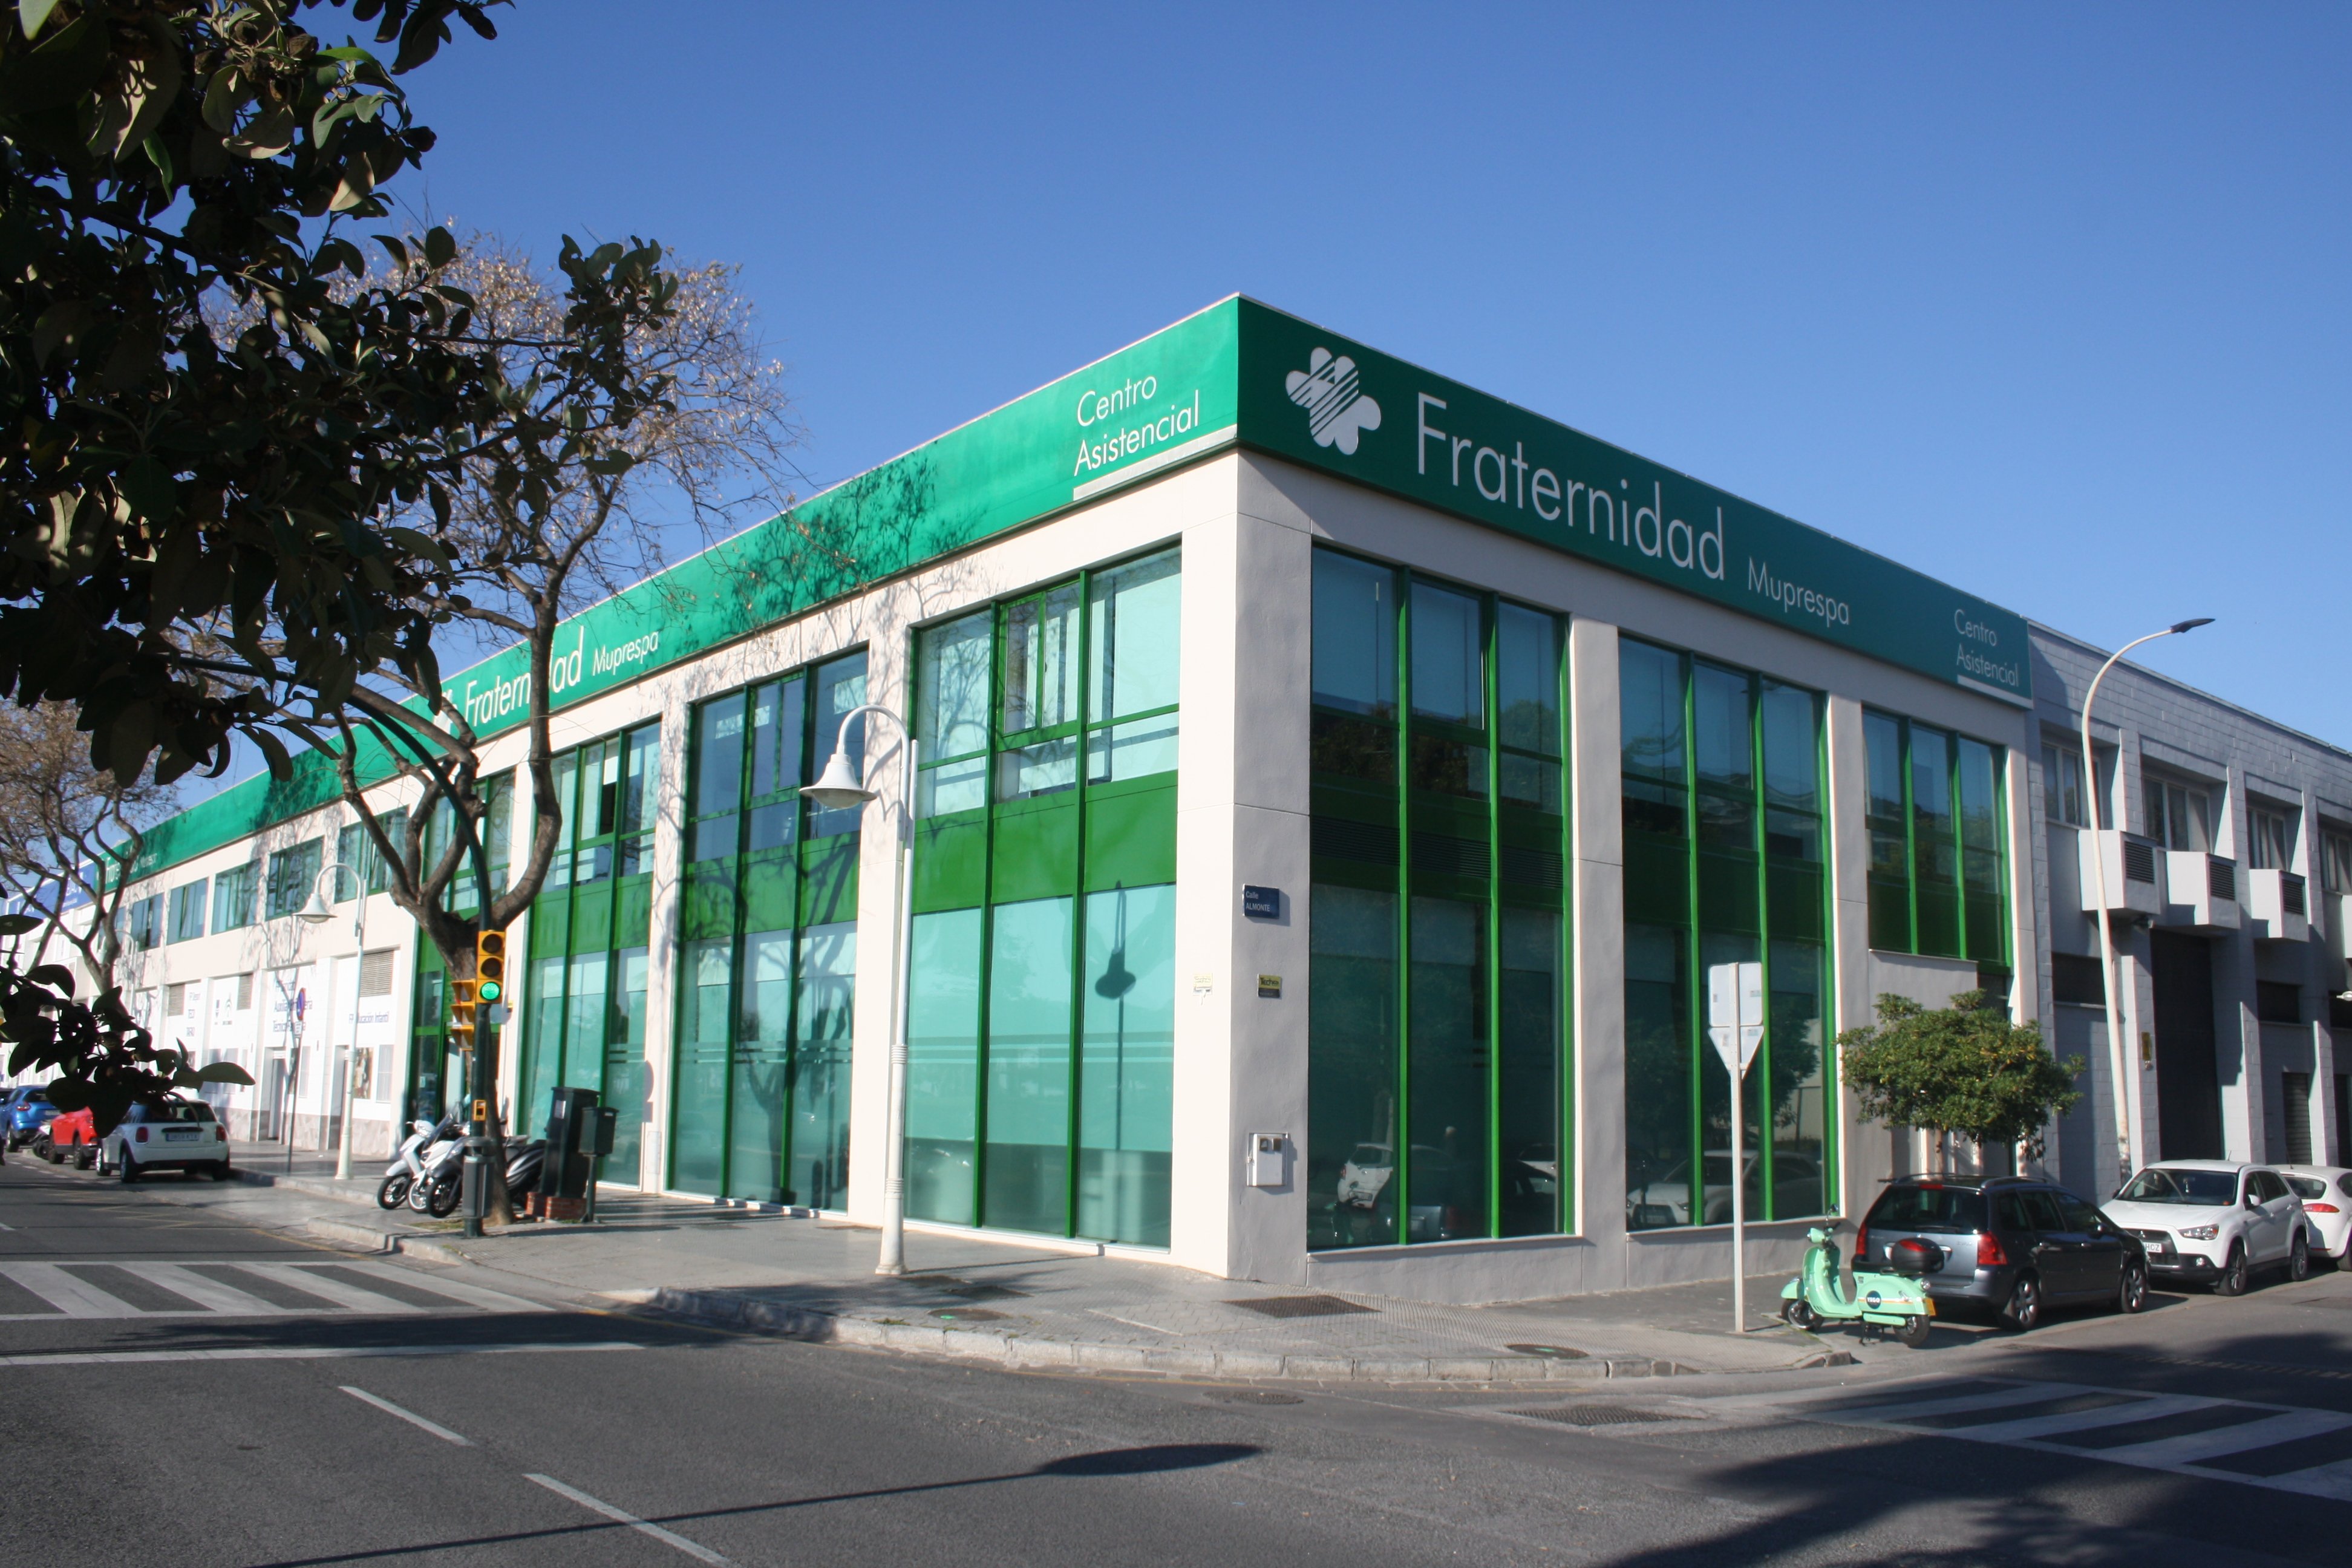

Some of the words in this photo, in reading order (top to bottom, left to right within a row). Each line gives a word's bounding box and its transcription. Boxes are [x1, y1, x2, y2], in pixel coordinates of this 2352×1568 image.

[1077, 376, 1157, 427] Centro
[1074, 389, 1199, 477] Asistencial
[1417, 392, 1725, 581] Fraternidad
[1748, 557, 1850, 627] Muprespa
[1954, 609, 1998, 647] Centro
[463, 625, 584, 728] Fraternad
[592, 630, 659, 676] Muprespa
[1956, 644, 2019, 687] Asistencial
[1246, 890, 1259, 900] Calle
[1246, 902, 1270, 912] ALMONTE
